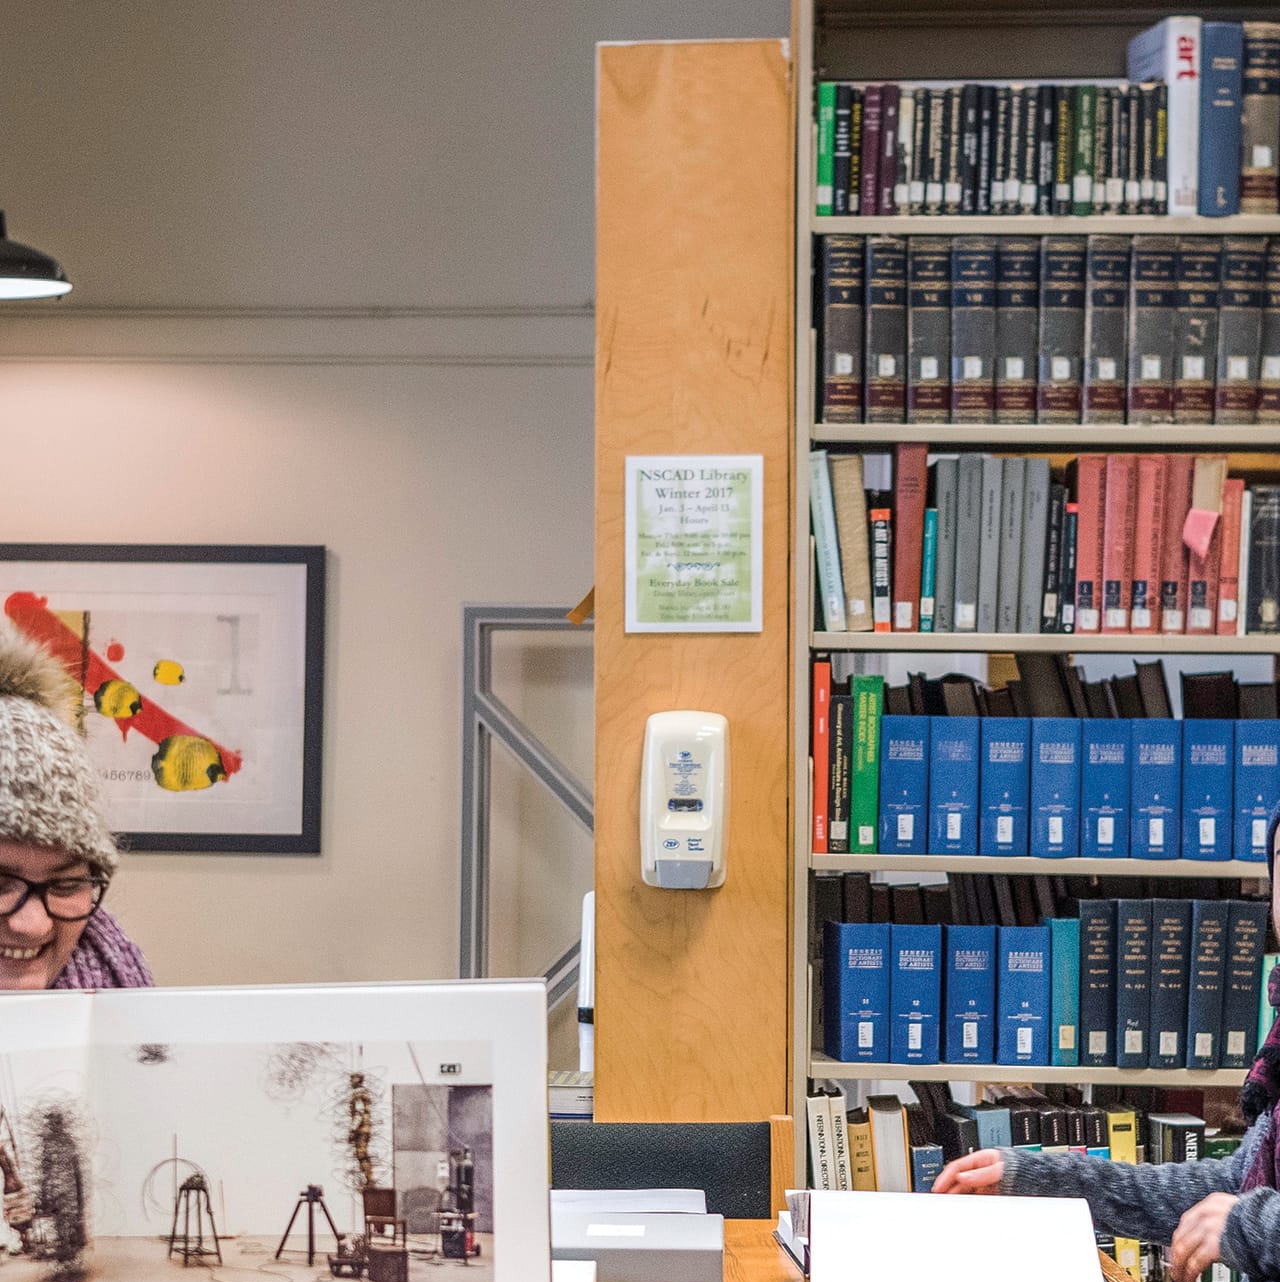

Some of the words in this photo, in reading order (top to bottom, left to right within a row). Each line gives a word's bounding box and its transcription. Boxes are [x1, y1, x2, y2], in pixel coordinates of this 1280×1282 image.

[1176, 36, 1198, 79] art
[640, 469, 696, 482] NSCAD
[700, 469, 749, 484] Library
[655, 487, 701, 500] Winter
[705, 487, 734, 500] 2017
[696, 504, 719, 515] April
[679, 516, 709, 525] Hours
[874, 528, 887, 541] ART
[874, 543, 887, 557] AND
[874, 559, 888, 586] ARTISTS
[649, 579, 692, 590] Everyday
[694, 578, 719, 587] Book
[666, 840, 679, 849] ZEP
[816, 1115, 826, 1157] INTERNATIONAL
[834, 1115, 845, 1159] INTERNATIONAL
